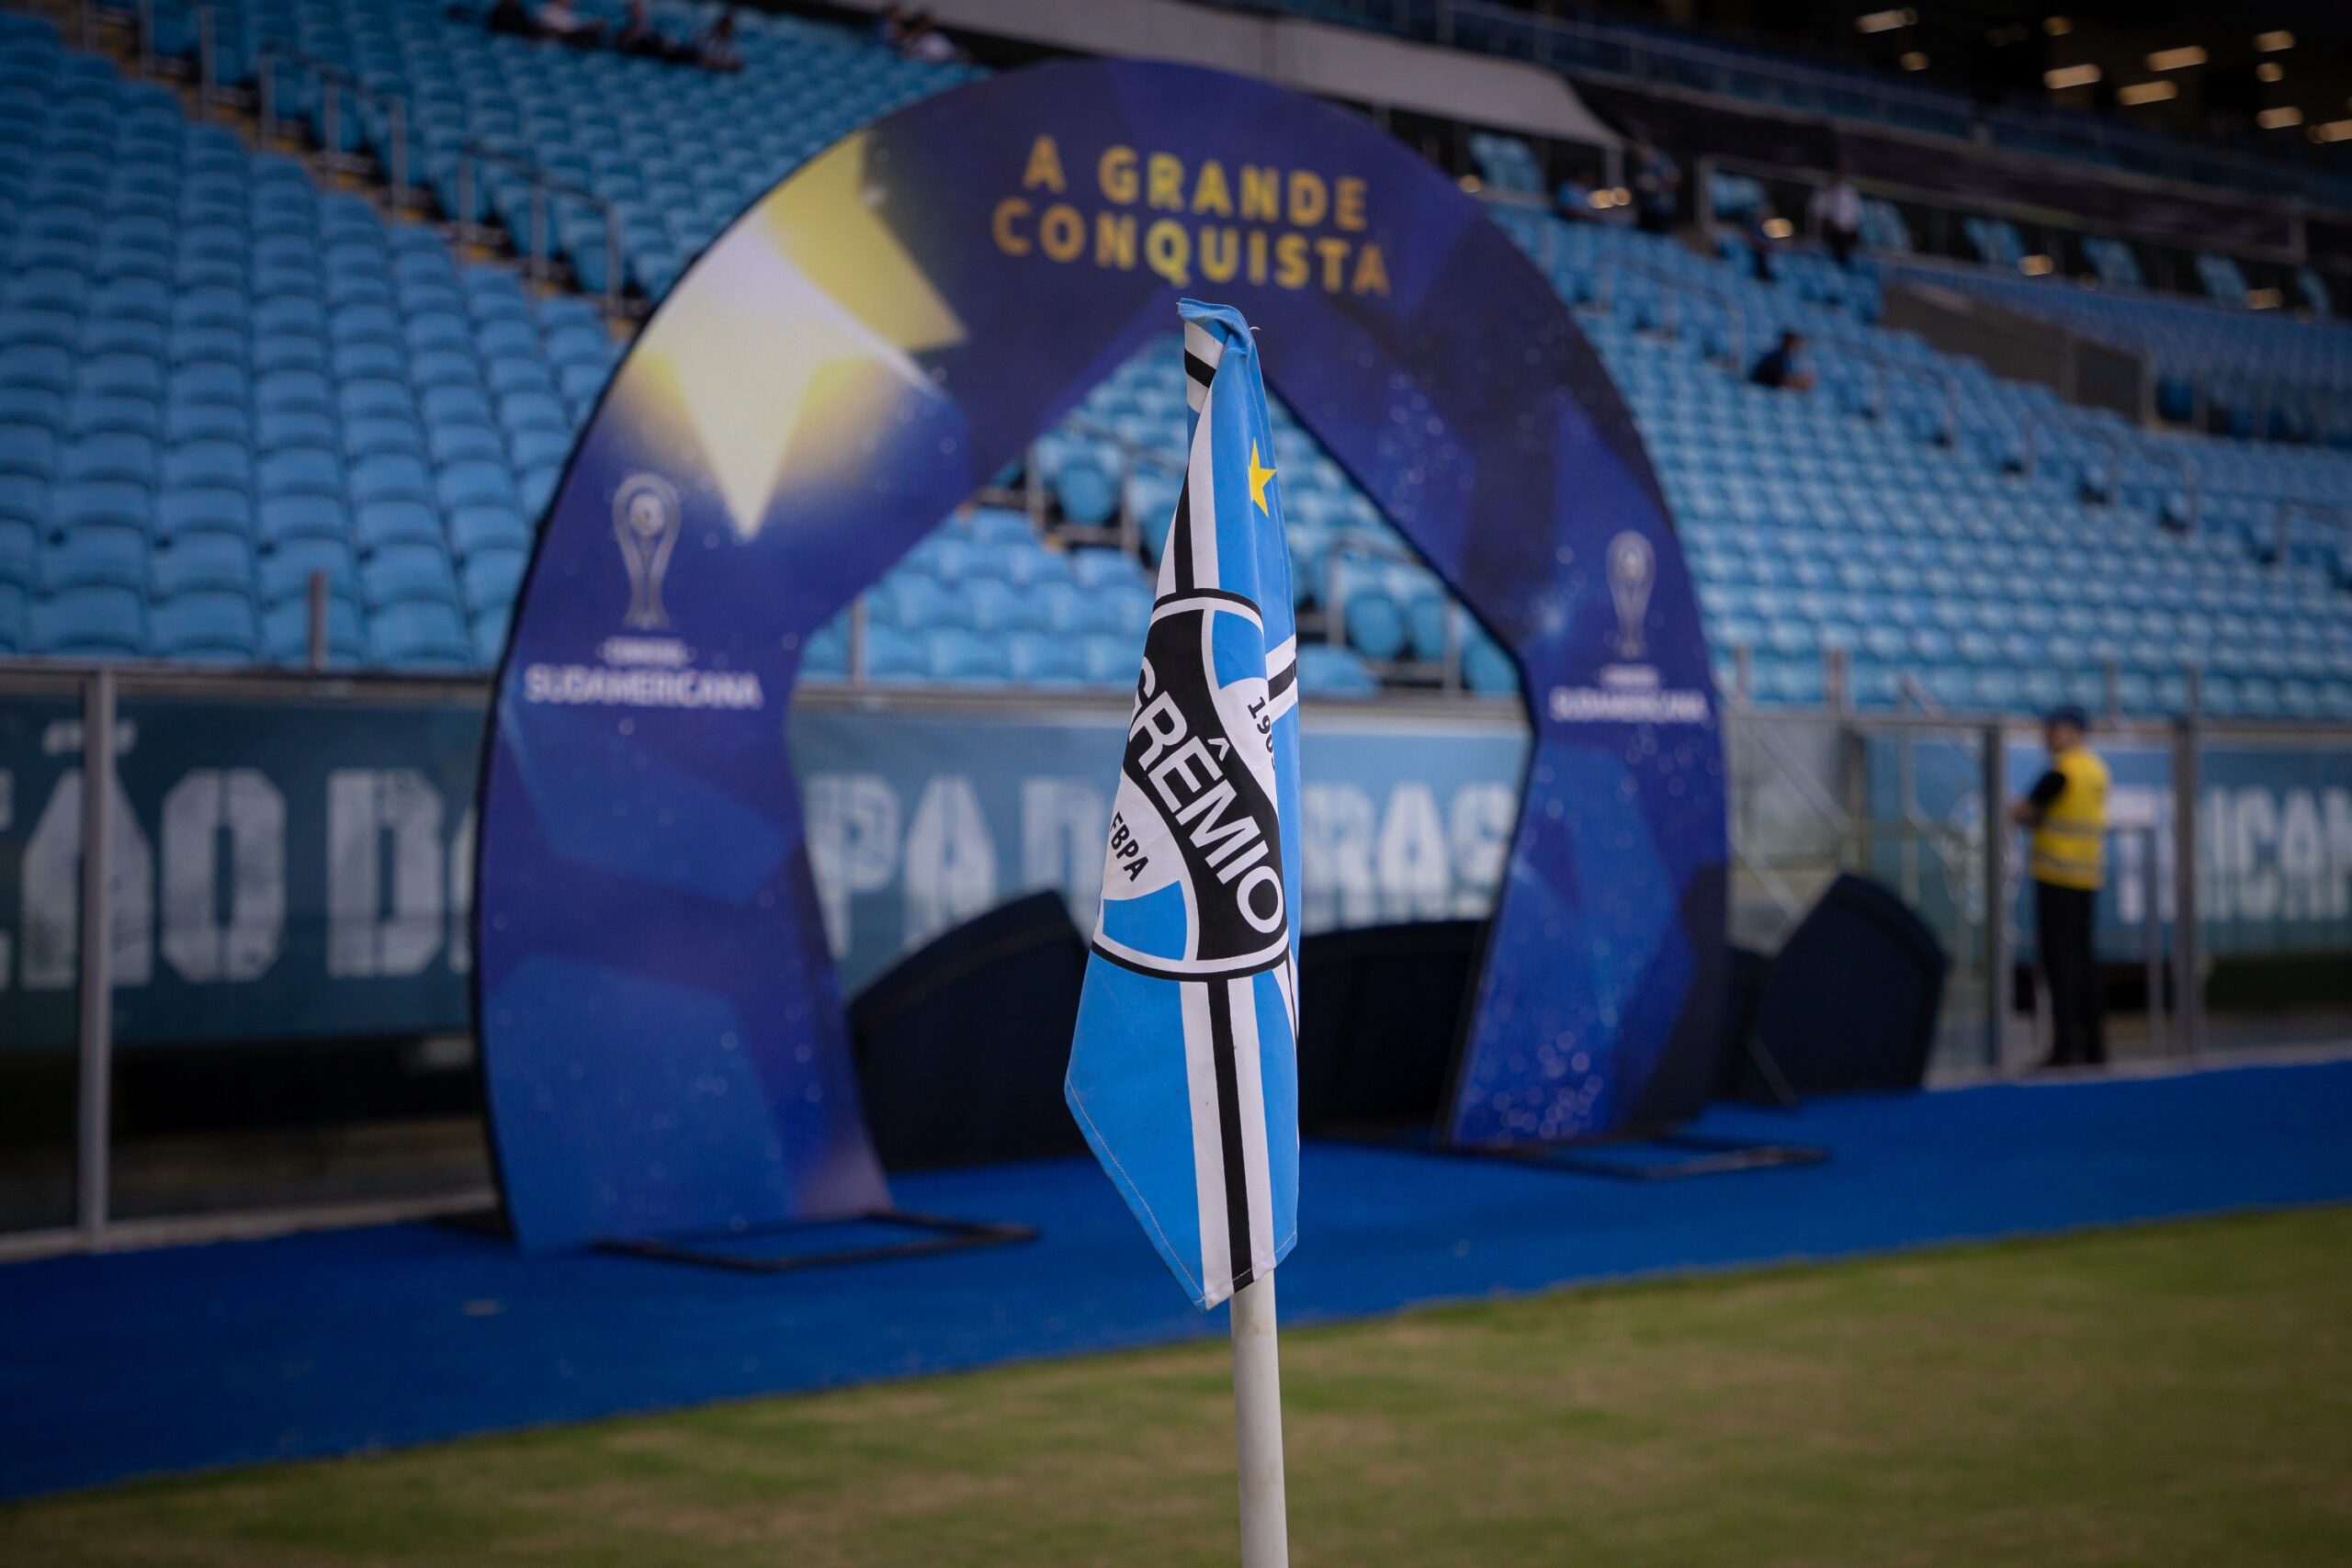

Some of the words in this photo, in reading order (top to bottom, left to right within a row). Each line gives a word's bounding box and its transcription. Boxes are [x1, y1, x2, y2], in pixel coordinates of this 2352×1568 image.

[1023, 134, 1067, 192] A
[1098, 144, 1367, 231] GRANDE
[992, 197, 1391, 296] CONQUISTA
[327, 770, 476, 978] D
